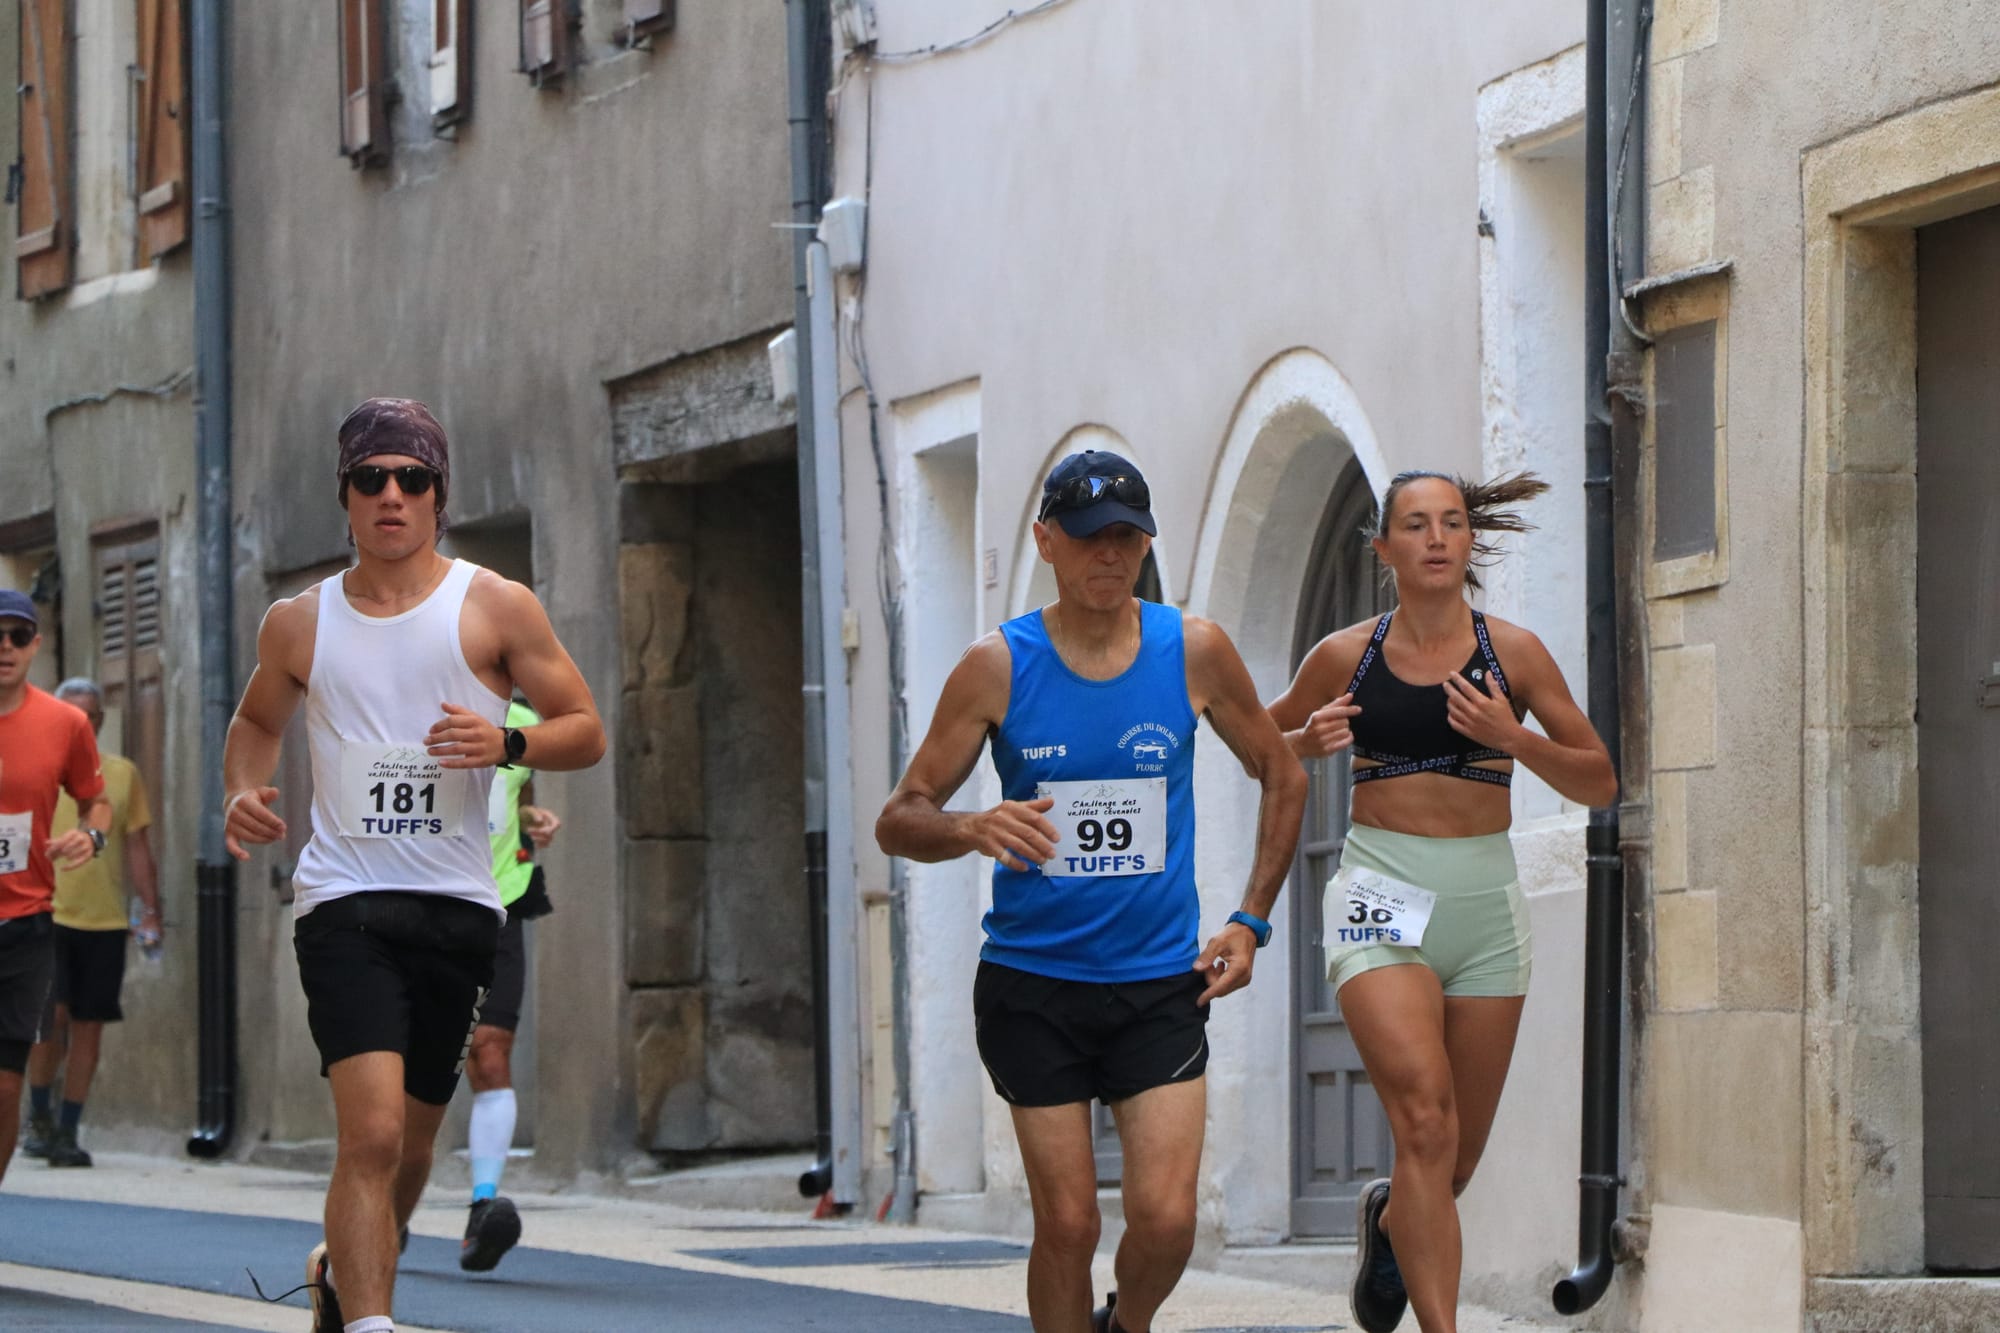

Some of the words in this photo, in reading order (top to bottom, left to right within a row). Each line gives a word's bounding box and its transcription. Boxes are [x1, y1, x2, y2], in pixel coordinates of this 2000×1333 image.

[1117, 724, 1143, 749] COURSE
[1143, 722, 1154, 731] DU
[1021, 744, 1068, 760] TUFF'S
[372, 761, 418, 773] Challenge
[1135, 763, 1164, 773] FLORAC
[1377, 762, 1418, 777] OCEANS
[1421, 755, 1459, 770] APART
[369, 781, 435, 814] 181
[1071, 800, 1117, 809] Challenge
[362, 817, 442, 835] TUFF'S
[1076, 817, 1133, 853] 99
[1064, 854, 1146, 873] TUFF'S
[1347, 899, 1394, 924] 36
[1338, 927, 1402, 942] TUFF'S
